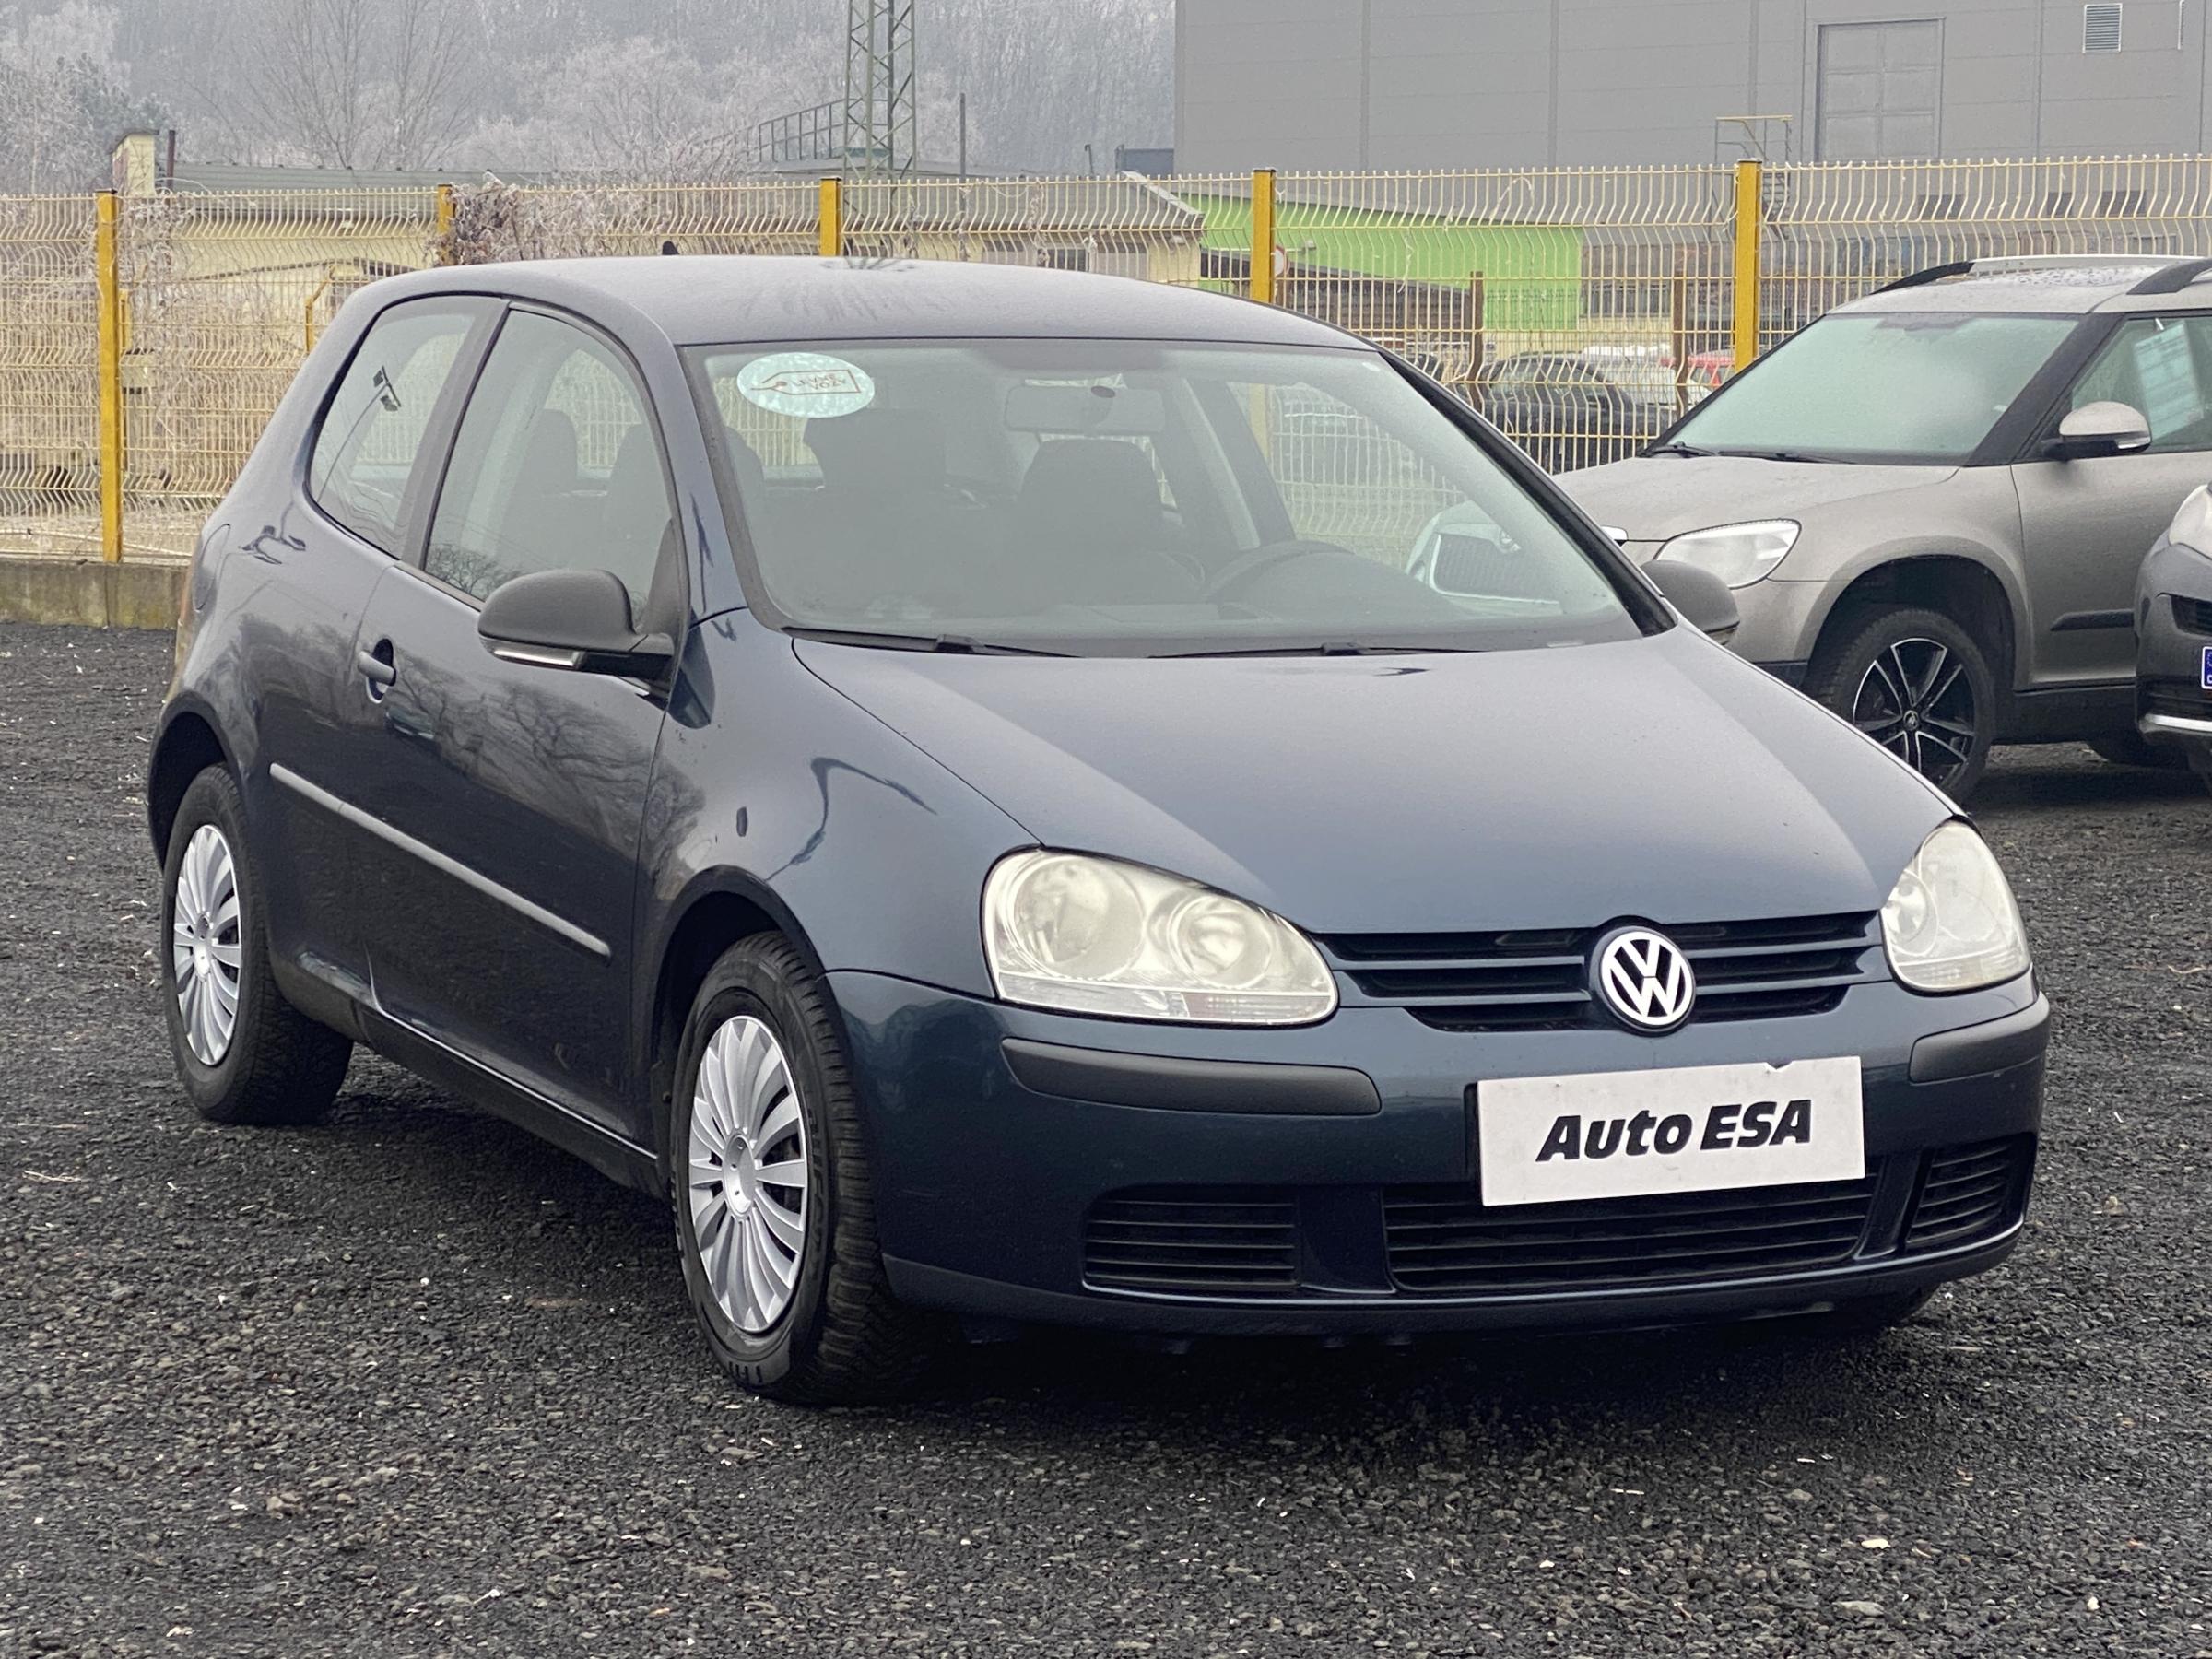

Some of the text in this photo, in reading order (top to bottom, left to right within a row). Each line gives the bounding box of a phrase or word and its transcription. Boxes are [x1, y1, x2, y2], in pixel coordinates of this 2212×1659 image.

[1601, 931, 1694, 1025] VW
[1535, 1100, 1811, 1161] Auto ESA
